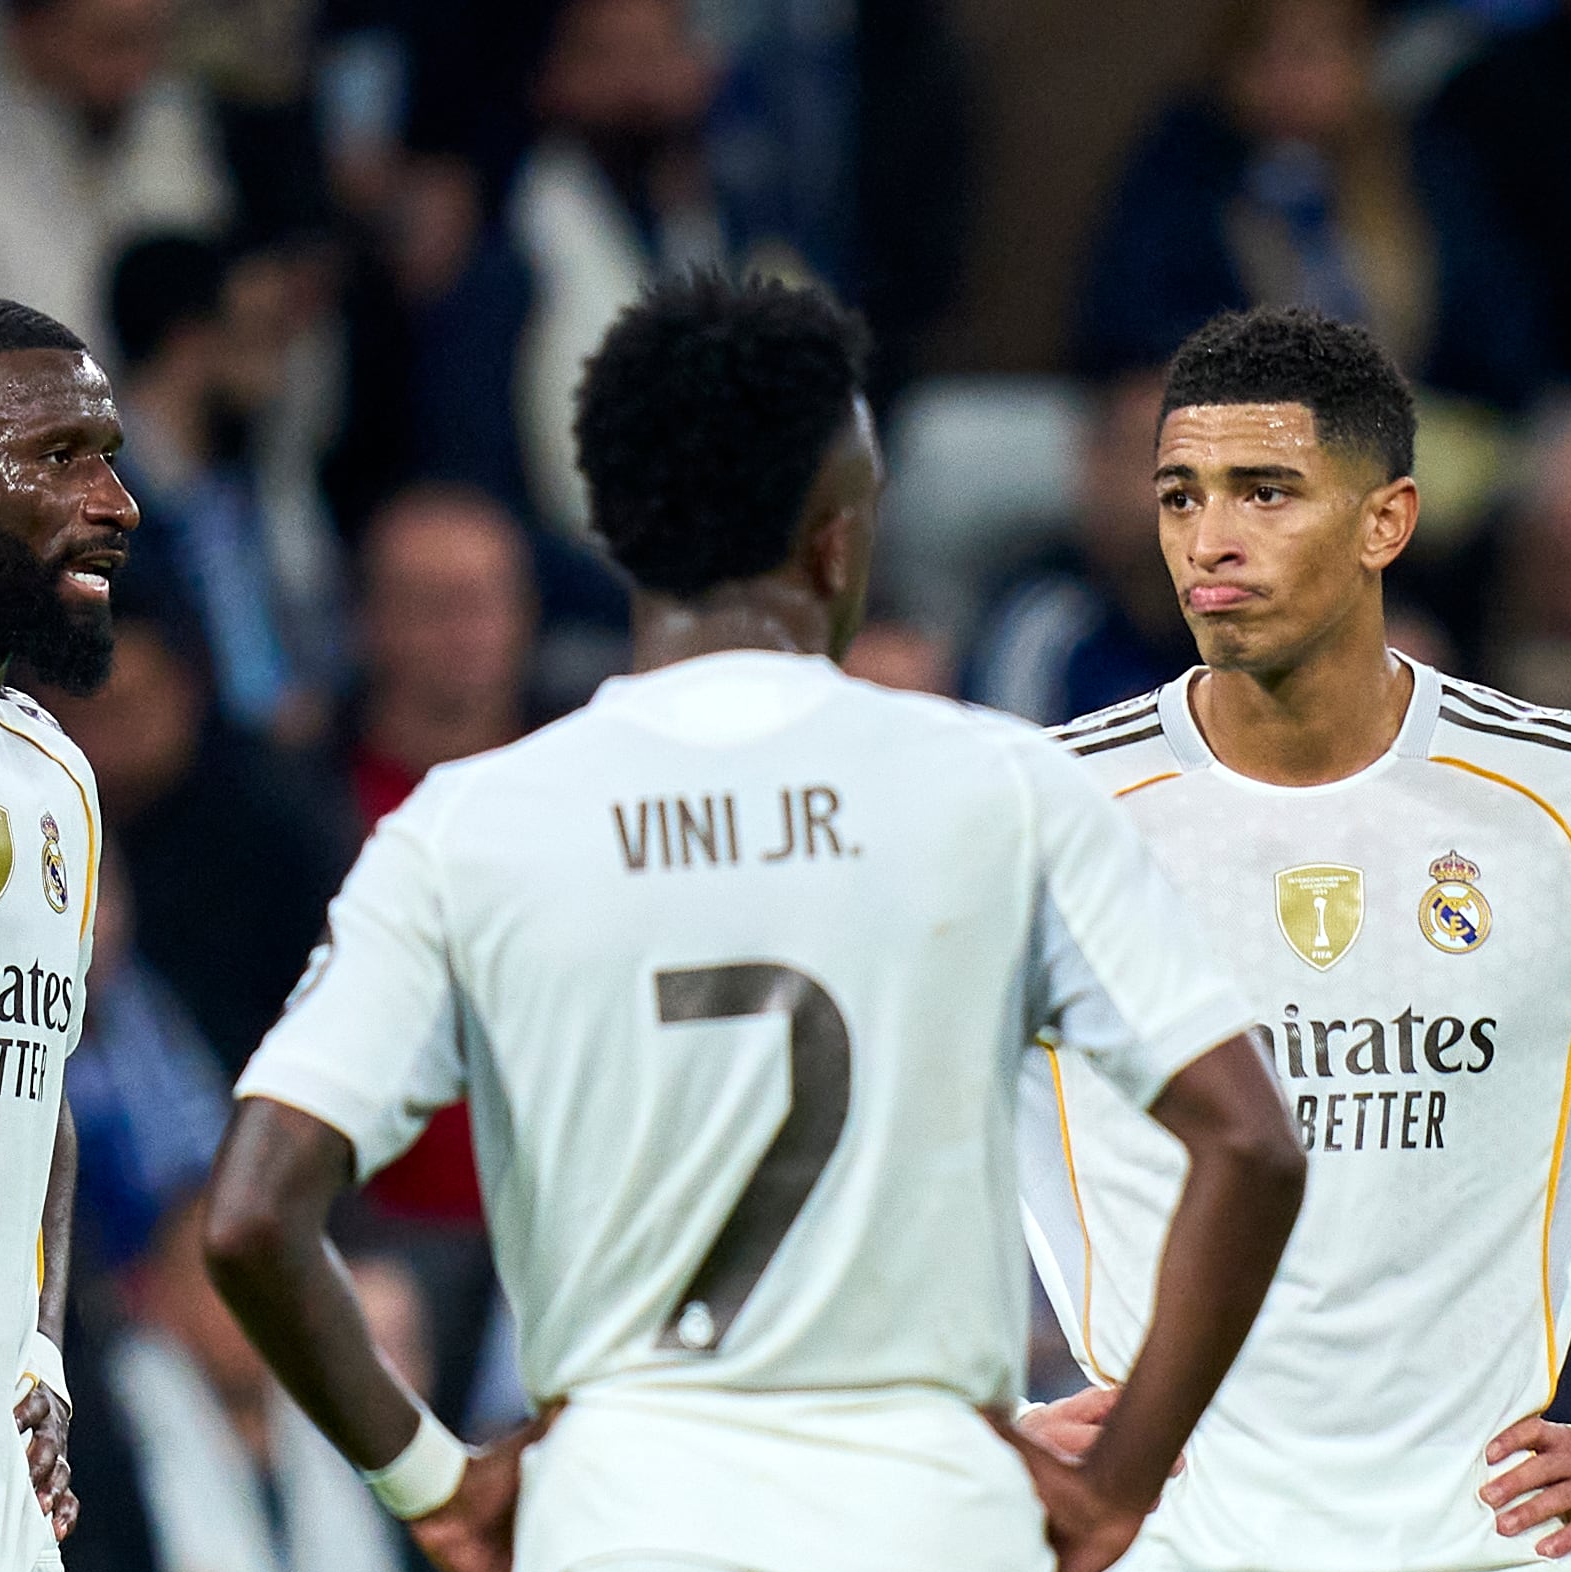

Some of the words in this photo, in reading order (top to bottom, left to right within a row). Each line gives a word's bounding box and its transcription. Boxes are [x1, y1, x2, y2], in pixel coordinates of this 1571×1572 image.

[611, 794, 740, 872] VINI
[760, 784, 864, 861] JR.
[1254, 1003, 1498, 1079] irates
[654, 962, 852, 1351] 7
[1296, 1090, 1447, 1152] BETTER
